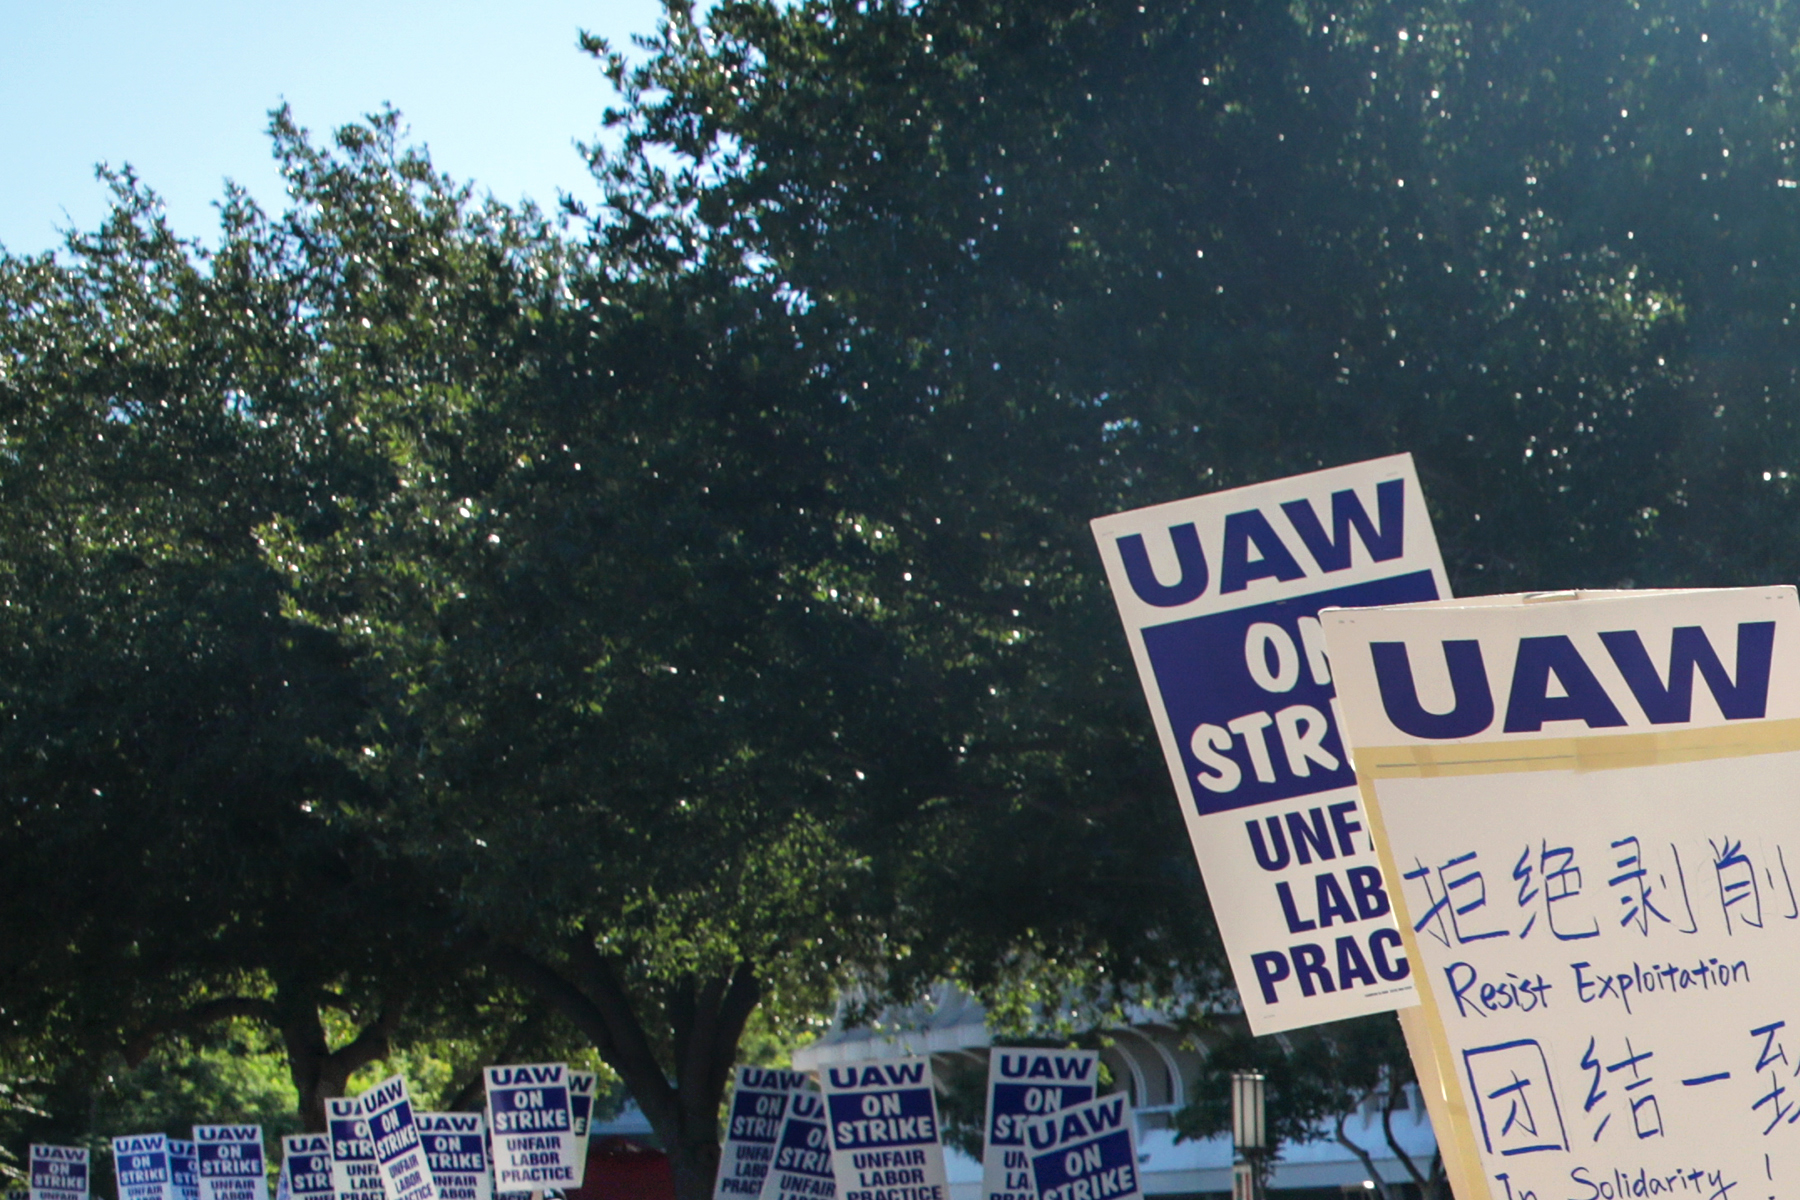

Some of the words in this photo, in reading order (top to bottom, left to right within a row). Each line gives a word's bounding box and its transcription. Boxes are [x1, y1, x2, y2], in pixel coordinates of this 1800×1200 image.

[1115, 477, 1405, 608] UAW
[1369, 621, 1775, 739] UAW
[1190, 704, 1346, 794] STR
[1245, 800, 1376, 872] UNF
[1402, 835, 1798, 948] 拒绝剥削
[1275, 865, 1392, 940] LAB
[1251, 927, 1411, 1005] PRAC
[1444, 961, 1553, 1017] Resist
[1573, 956, 1751, 1014] Exploitation
[490, 1066, 562, 1086] UAW
[828, 1063, 925, 1089] UAW
[1000, 1054, 1093, 1080] UAW
[742, 1068, 805, 1090] UAW
[363, 1079, 404, 1112] UAW
[514, 1090, 544, 1109] ON
[861, 1092, 902, 1117] ON
[1024, 1087, 1063, 1112] ON
[381, 1109, 401, 1133] ON
[415, 1116, 477, 1131] UAW
[494, 1109, 568, 1131] STRIKE
[1027, 1099, 1124, 1150] UAW
[199, 1127, 257, 1140] UAW
[837, 1116, 934, 1145] STRIKE
[115, 1136, 163, 1153] UAW
[217, 1145, 242, 1159] ON
[288, 1137, 330, 1153] UA
[377, 1124, 418, 1160] STRIKE
[434, 1136, 461, 1152] ON
[506, 1136, 561, 1151] UNFAIR
[34, 1146, 85, 1160] UAW
[132, 1156, 150, 1168] ON
[428, 1152, 483, 1169] TRIKE
[511, 1151, 560, 1166] LABOR
[853, 1149, 926, 1170] UNFAIR
[1065, 1143, 1103, 1177] ON
[49, 1163, 70, 1175] ON
[121, 1168, 166, 1184] STRIKE
[201, 1160, 260, 1174] STRIKE
[389, 1154, 420, 1179] UNFAIR
[501, 1166, 574, 1183] PRACTICE
[35, 1174, 85, 1189] STRIKE
[211, 1179, 256, 1189] UNFAIR
[394, 1171, 423, 1194] LABOR
[433, 1175, 478, 1187] NFAIR
[780, 1174, 836, 1198] UNFAIR
[859, 1168, 925, 1188] LABOR
[127, 1185, 163, 1196] UNFAIR
[214, 1191, 254, 1200] LABOR
[440, 1189, 476, 1200] ABOR
